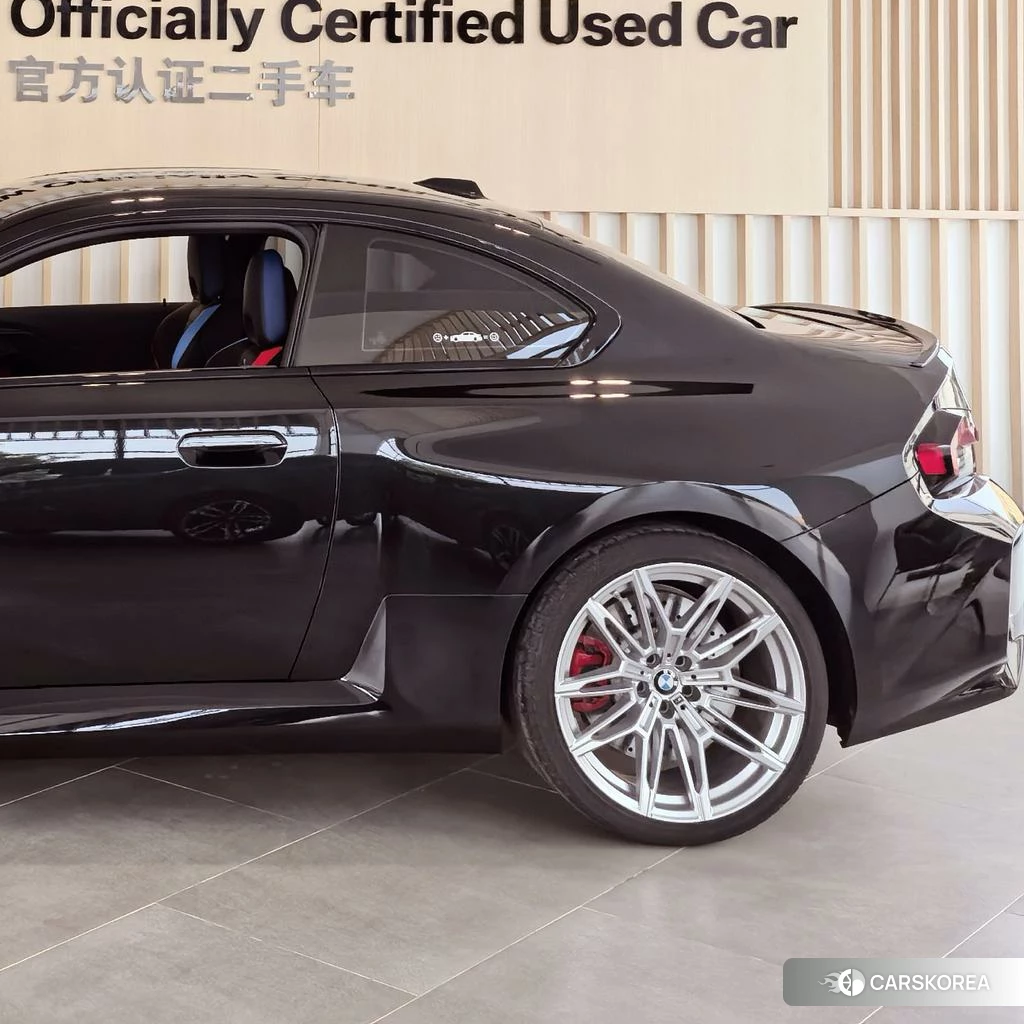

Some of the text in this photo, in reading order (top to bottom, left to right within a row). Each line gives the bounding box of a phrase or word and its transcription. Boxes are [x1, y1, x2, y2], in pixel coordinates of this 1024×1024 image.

[696, 1, 799, 49] Car
[8, 54, 355, 107] 官方认证二手车
